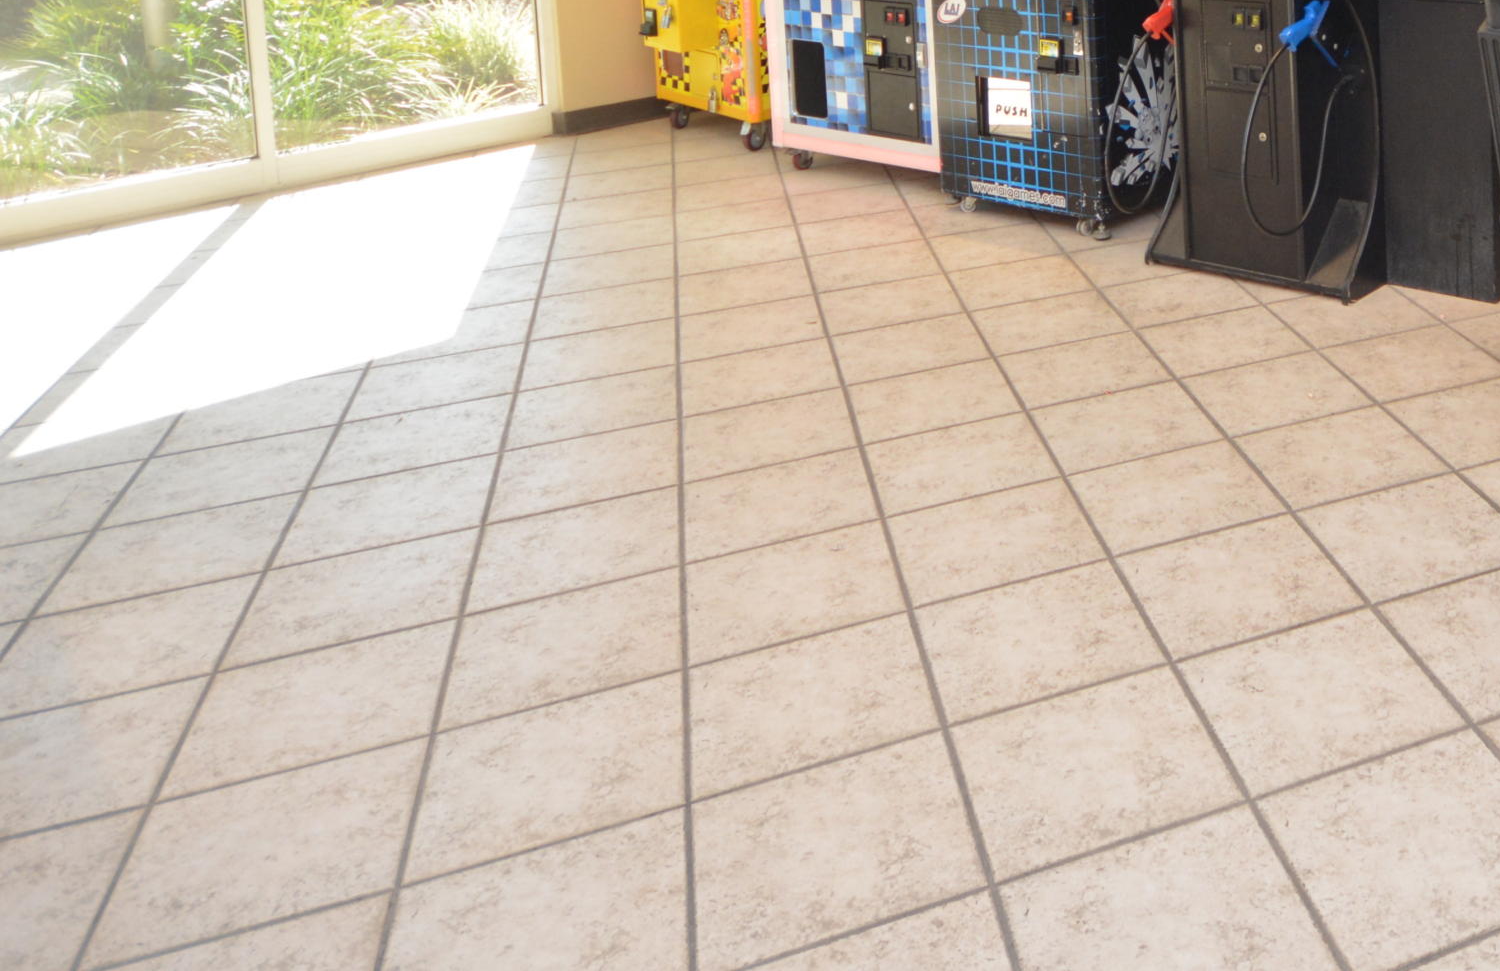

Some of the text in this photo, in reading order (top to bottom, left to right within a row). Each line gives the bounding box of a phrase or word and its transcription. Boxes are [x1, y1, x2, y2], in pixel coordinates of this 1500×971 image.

[943, 2, 960, 16] LAI
[995, 104, 1028, 117] PUSH
[970, 179, 1066, 208] www.laigames.com
